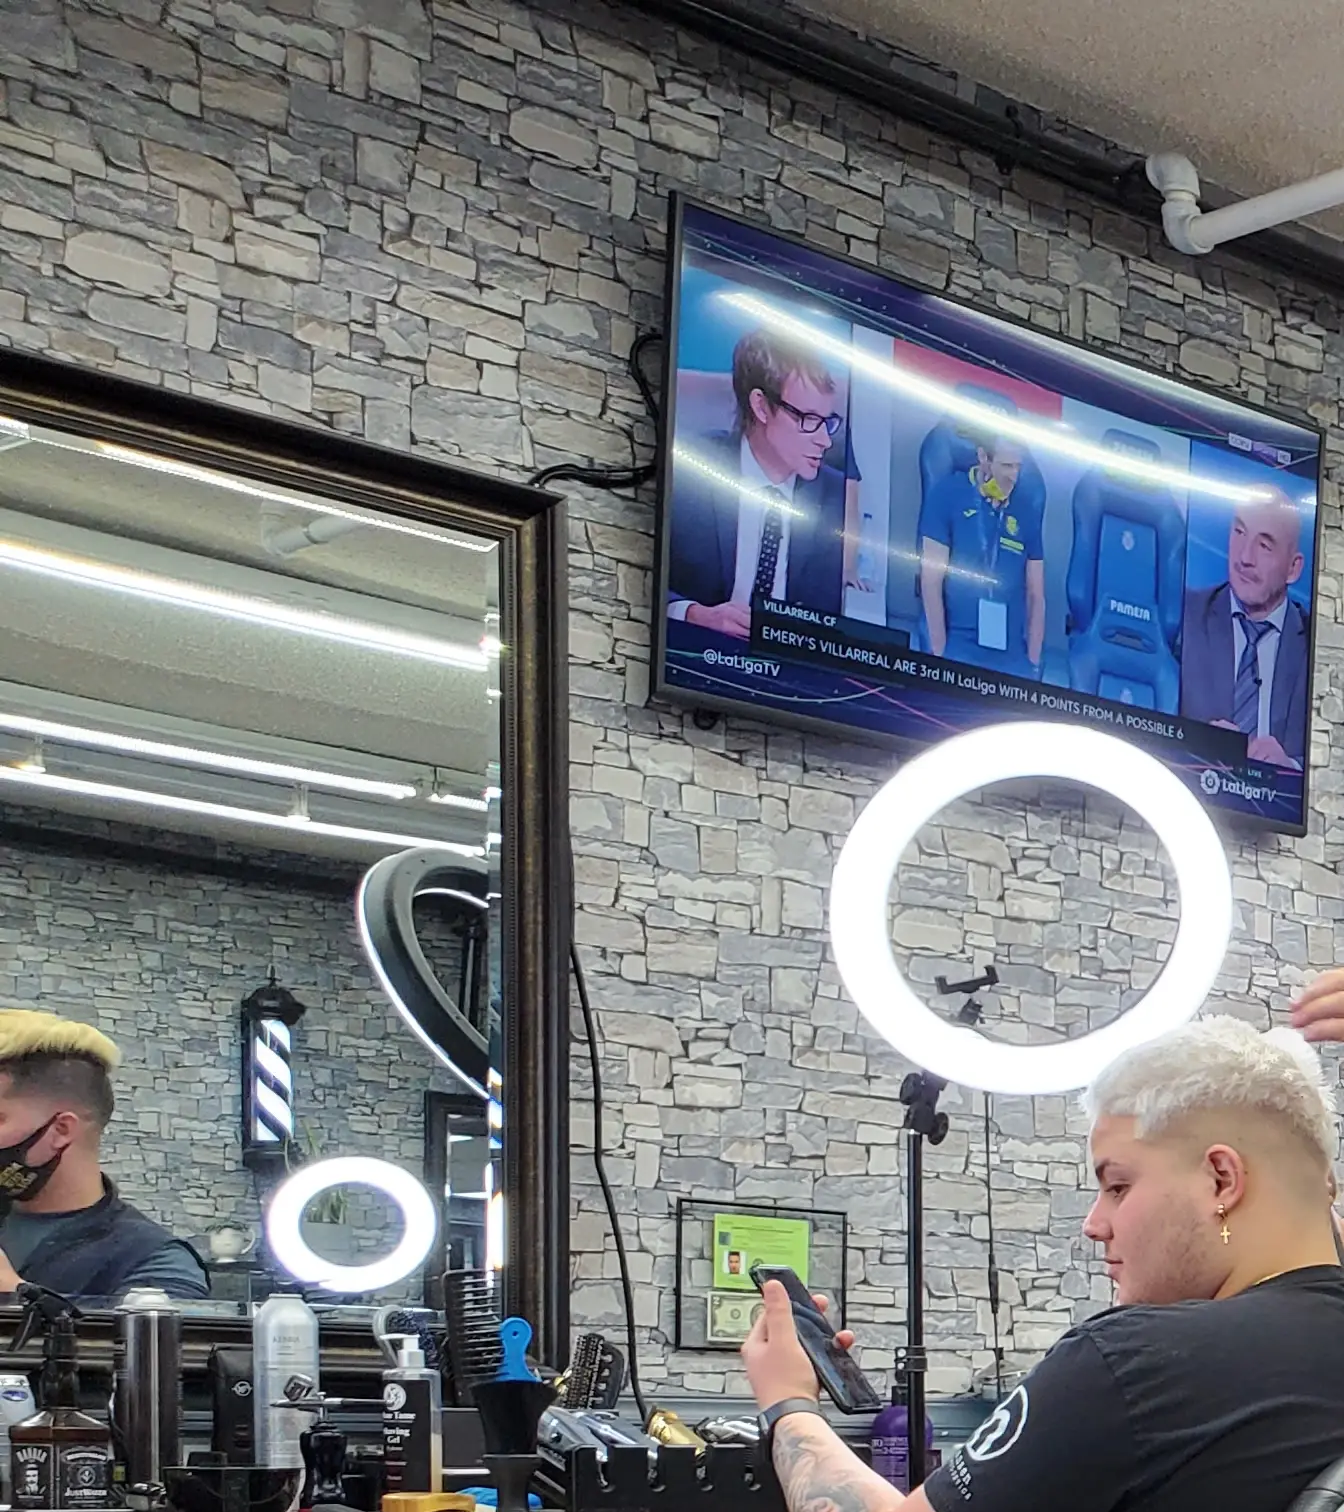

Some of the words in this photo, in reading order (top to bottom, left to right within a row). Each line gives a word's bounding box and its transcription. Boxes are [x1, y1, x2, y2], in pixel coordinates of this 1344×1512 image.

[763, 600, 821, 624] VILLARREAL
[823, 617, 837, 627] CF
[703, 649, 781, 677] @LaLigaTV
[762, 626, 816, 650] EMERY'S
[819, 639, 890, 669] VILLARREAL
[893, 661, 917, 675] ARE
[919, 664, 940, 681] 3rd
[942, 670, 955, 685] IN
[957, 674, 997, 696] LaLiga
[999, 683, 1028, 702] WITH
[1030, 692, 1038, 704] 4
[1040, 694, 1080, 715] POINTS
[1082, 704, 1114, 723] FROM
[1116, 714, 1124, 725] A
[1126, 715, 1175, 738] POSSIBLE
[1177, 727, 1184, 739] 6
[1222, 778, 1277, 802] LaLigaTV
